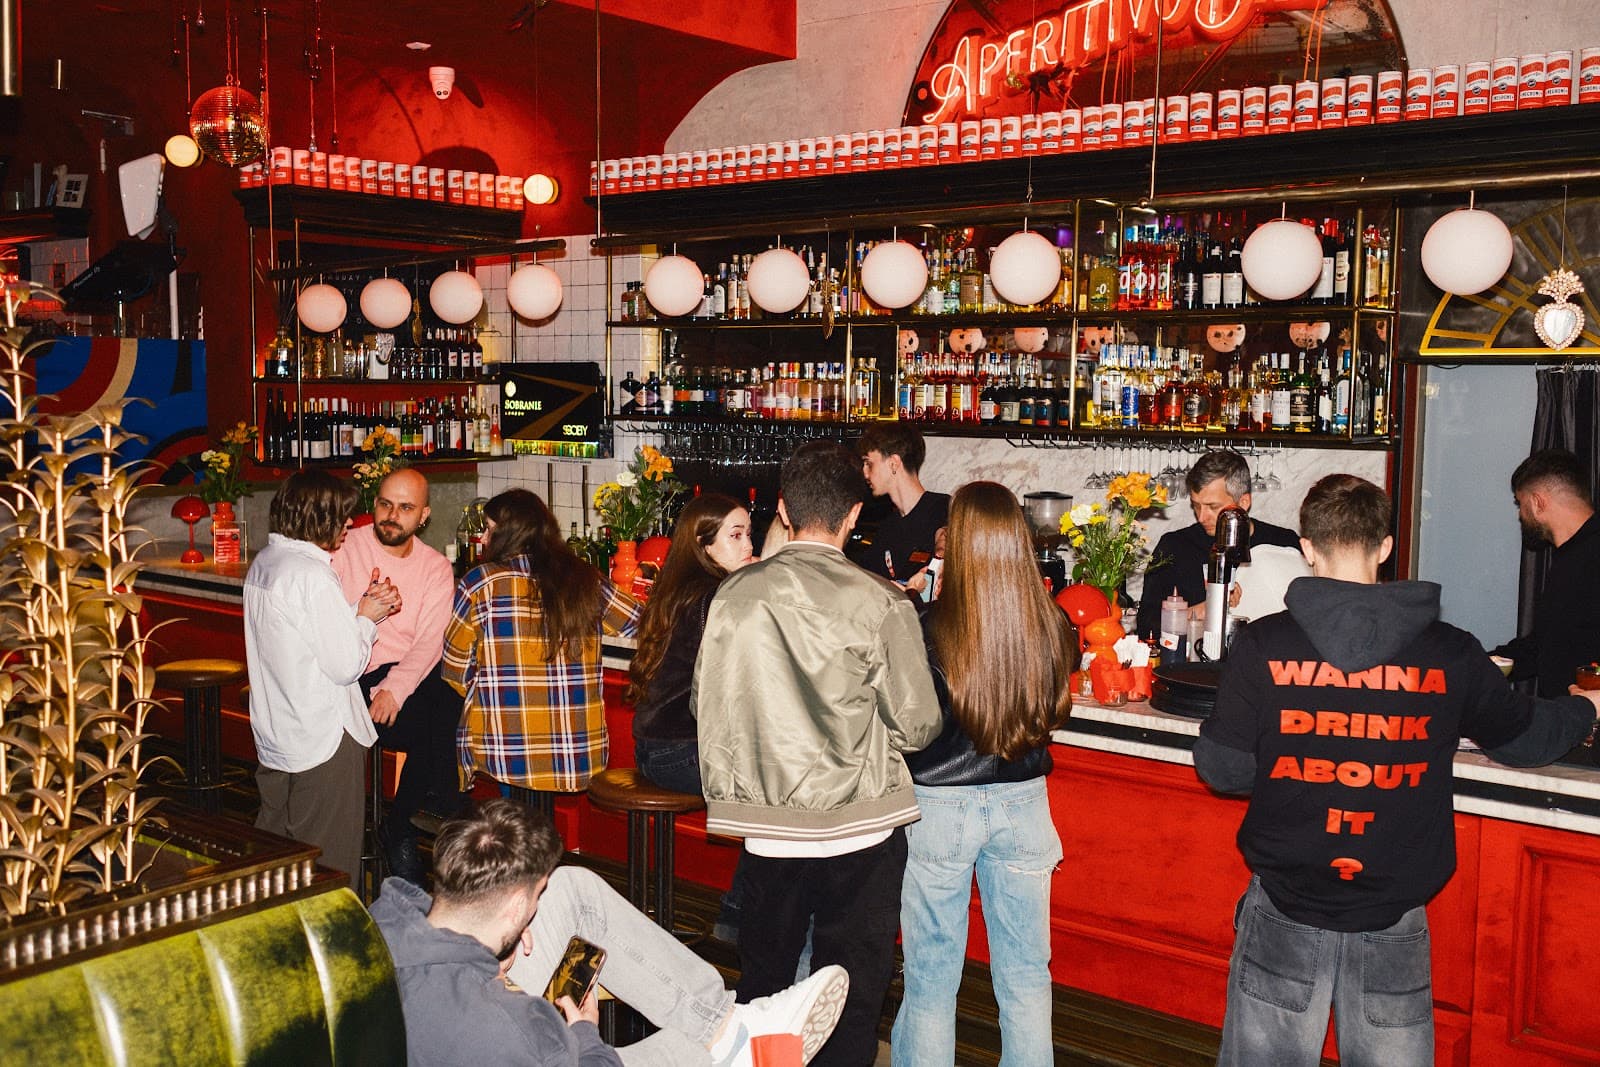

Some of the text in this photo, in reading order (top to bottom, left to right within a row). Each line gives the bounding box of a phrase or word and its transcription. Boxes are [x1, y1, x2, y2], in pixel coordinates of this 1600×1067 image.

[1268, 660, 1447, 694] WANNA
[1280, 709, 1432, 741] DRINK
[1269, 756, 1429, 790] ABOUT
[1326, 808, 1375, 835] IT
[1329, 857, 1364, 881] ?
